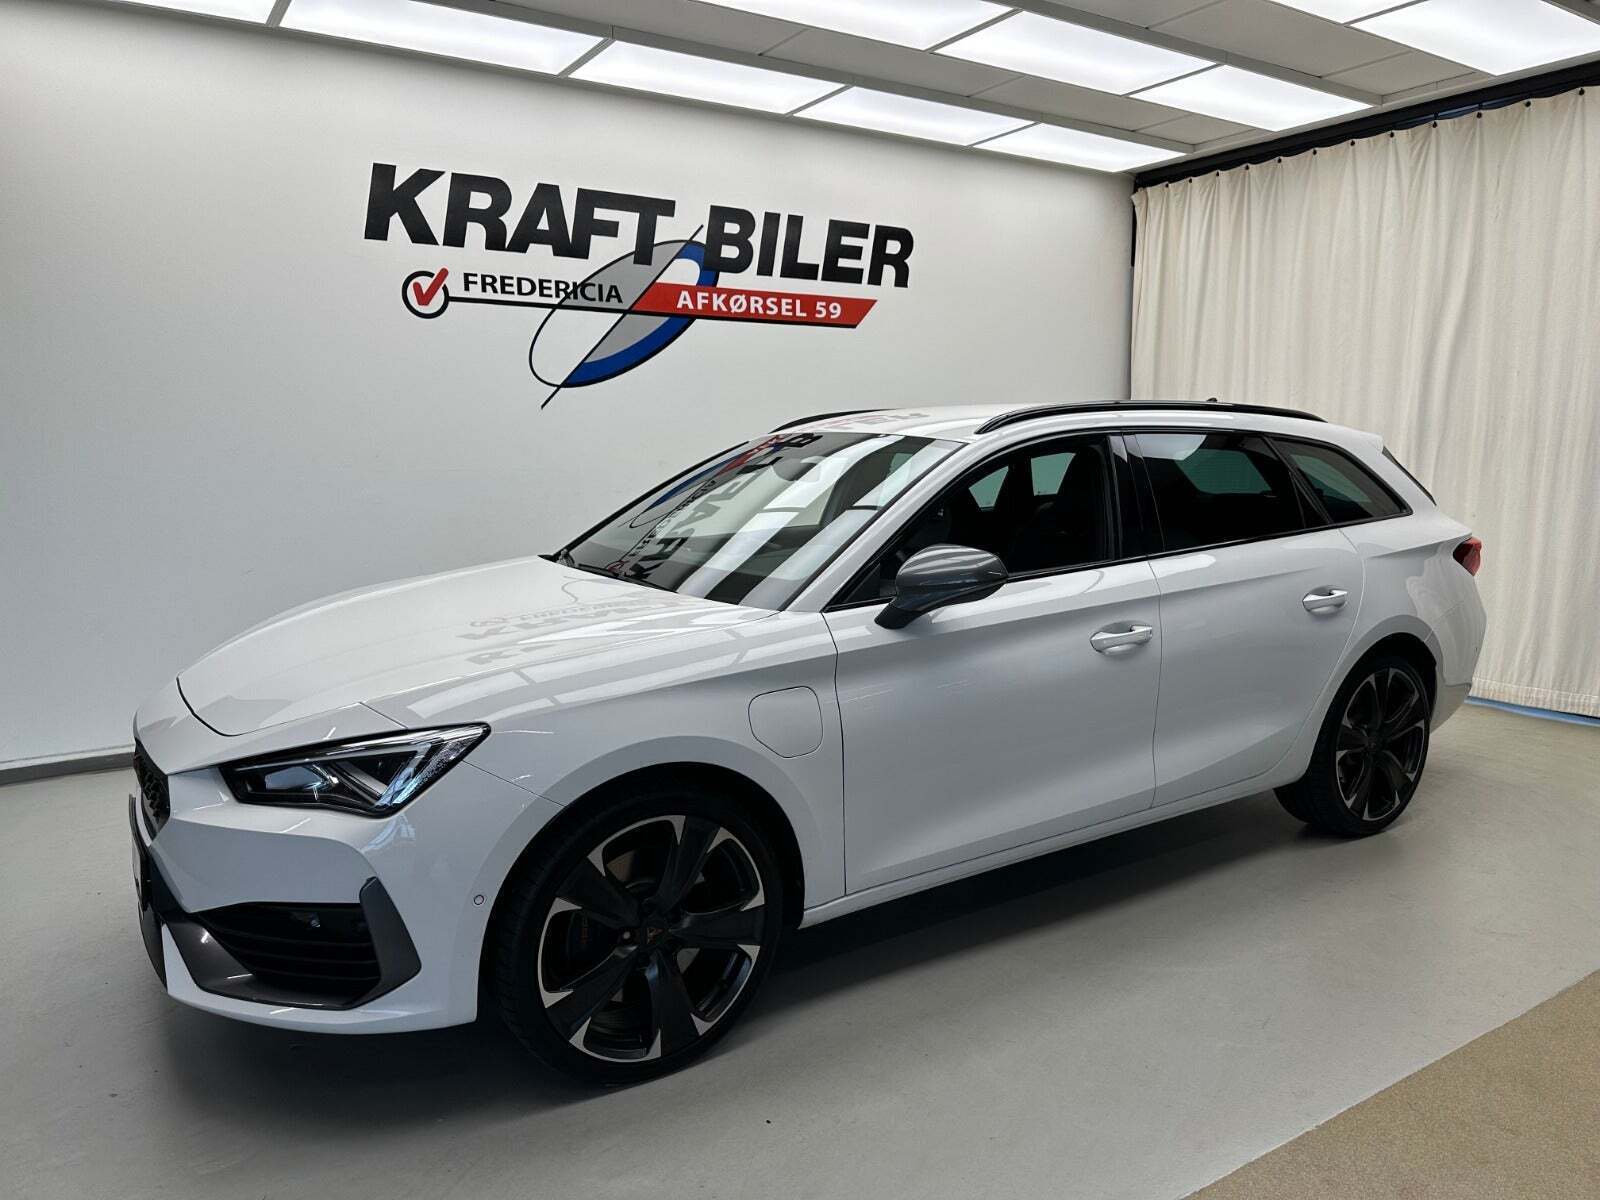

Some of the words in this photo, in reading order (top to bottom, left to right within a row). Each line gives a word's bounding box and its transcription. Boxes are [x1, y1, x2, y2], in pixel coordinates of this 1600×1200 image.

[364, 162, 676, 266] KRAFT
[703, 204, 915, 289] BILER
[462, 272, 623, 304] FREDERICIA
[676, 290, 808, 318] AFKØRSEL
[815, 301, 843, 320] 59
